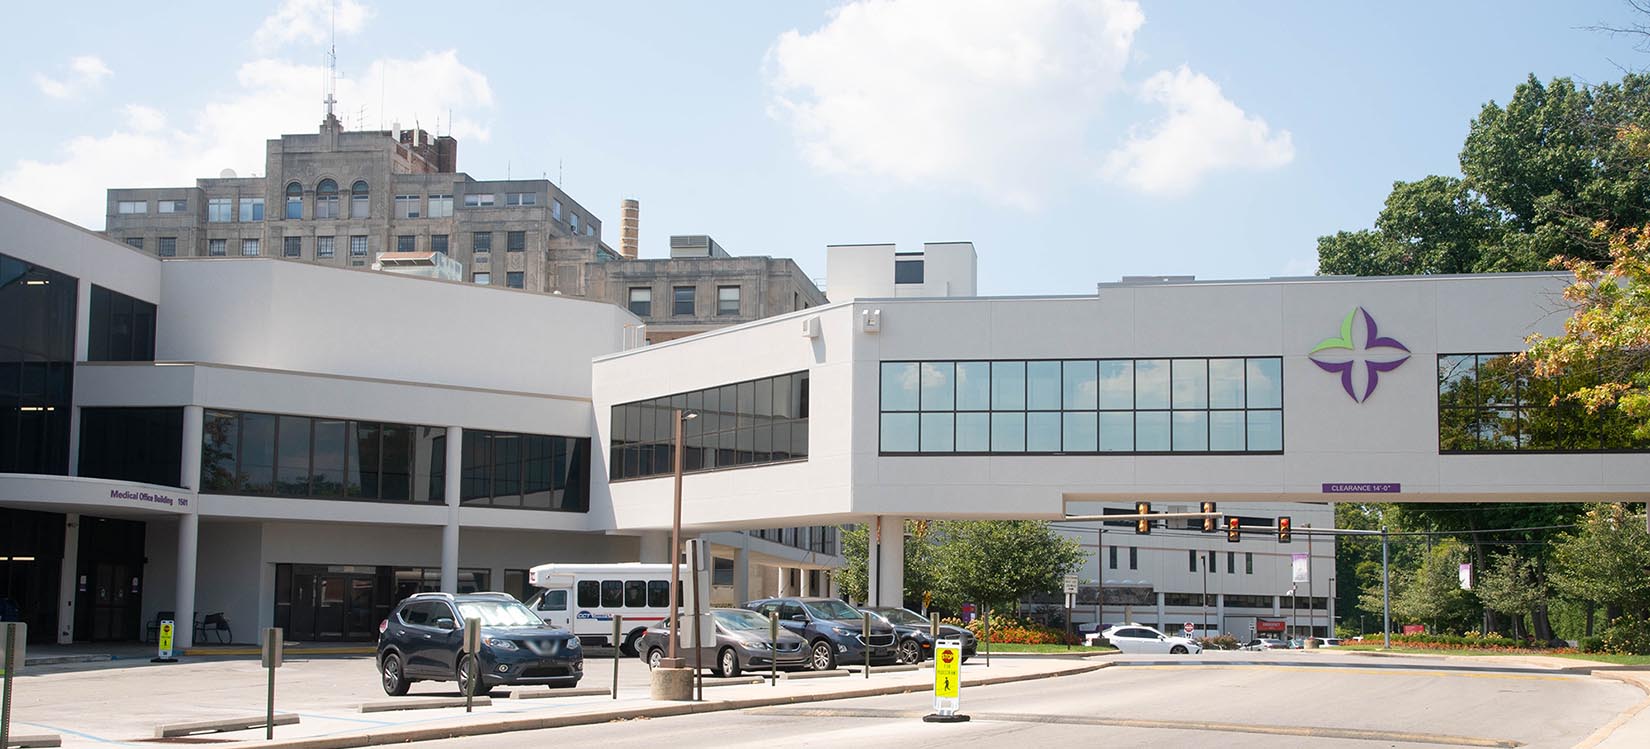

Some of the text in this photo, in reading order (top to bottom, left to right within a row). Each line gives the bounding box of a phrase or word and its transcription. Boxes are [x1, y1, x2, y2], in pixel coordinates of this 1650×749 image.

[110, 490, 138, 500] Medical
[140, 492, 153, 501] Office
[154, 494, 173, 506] Building
